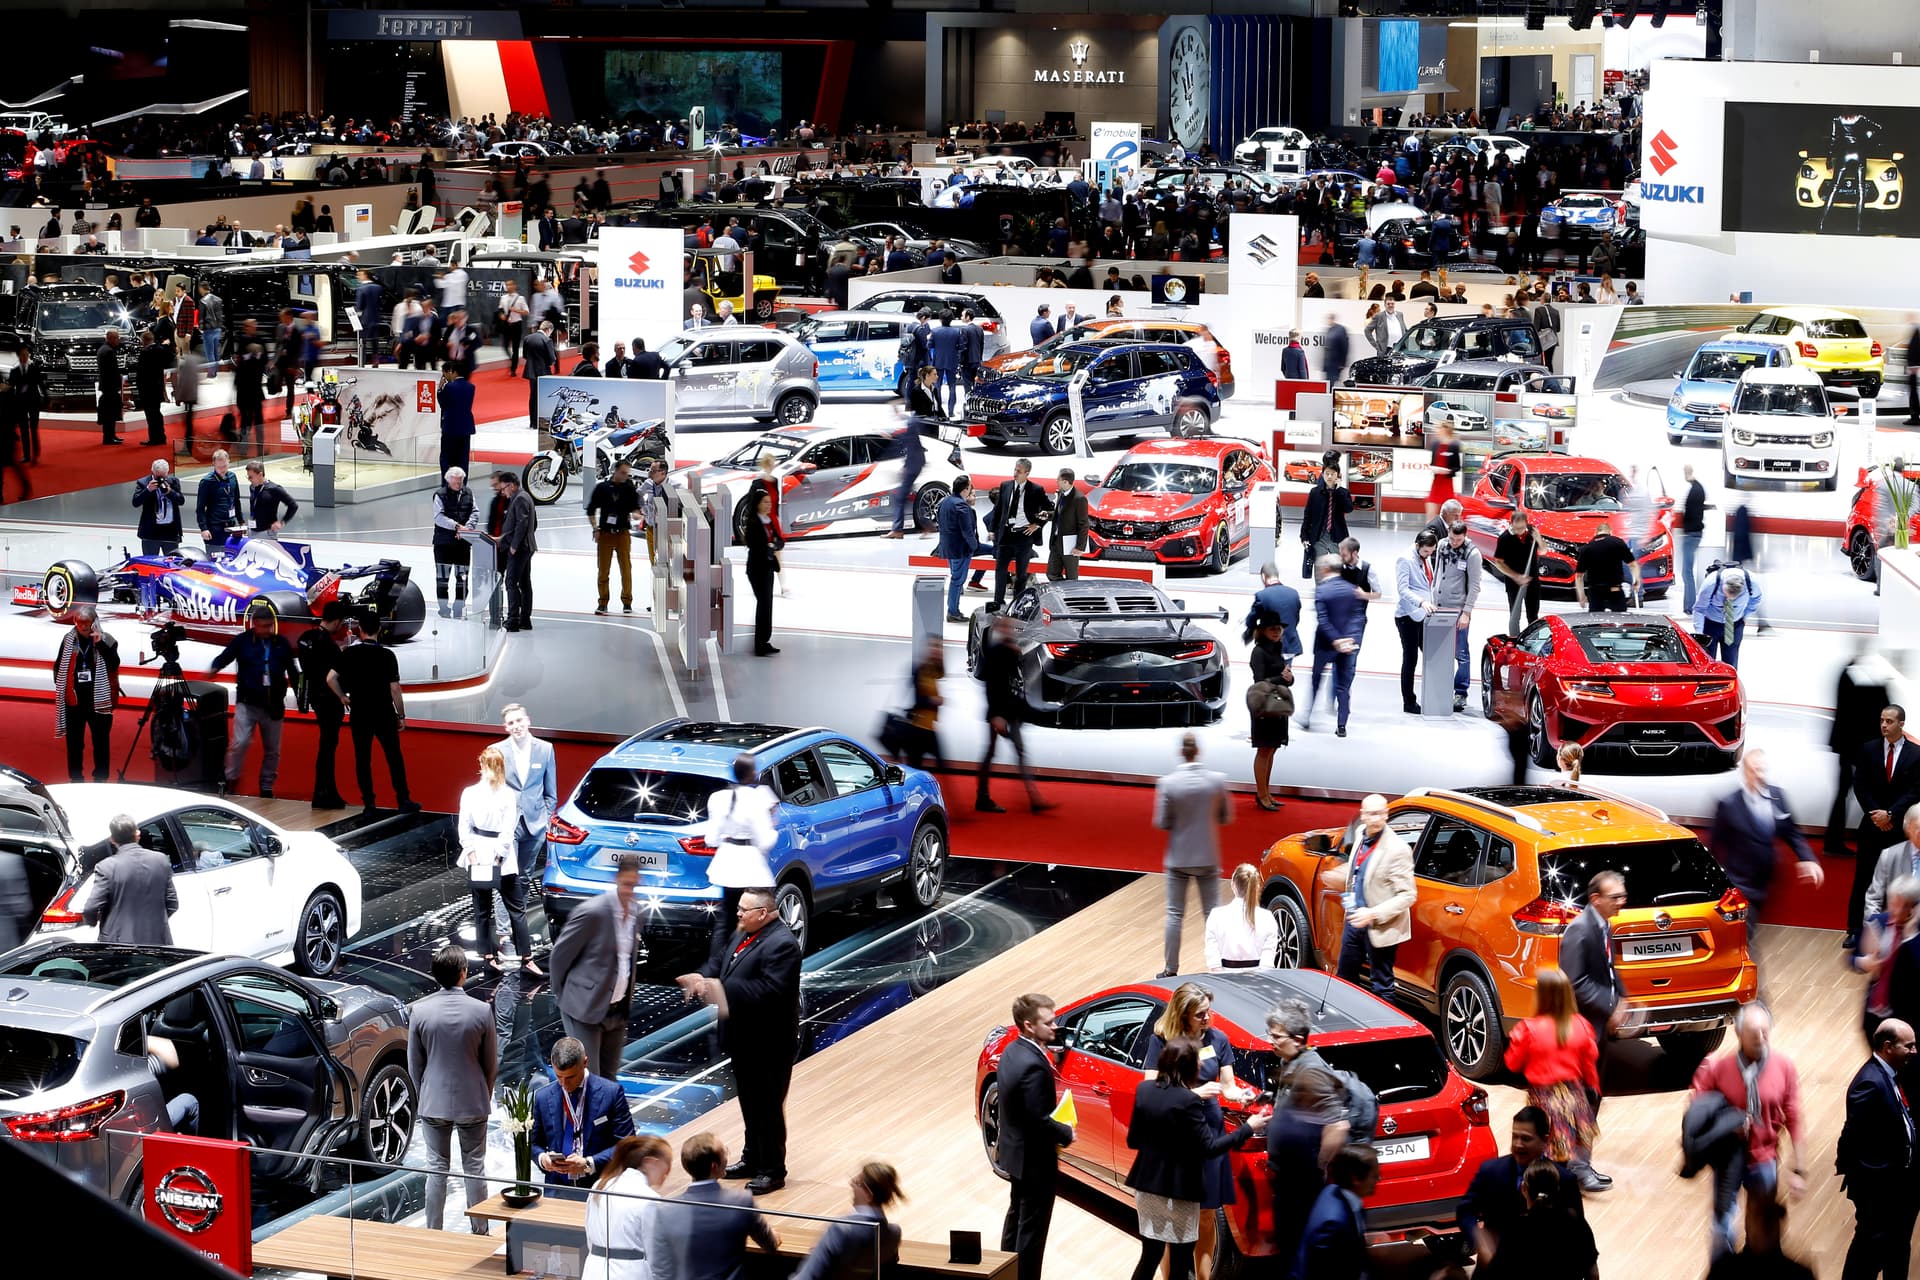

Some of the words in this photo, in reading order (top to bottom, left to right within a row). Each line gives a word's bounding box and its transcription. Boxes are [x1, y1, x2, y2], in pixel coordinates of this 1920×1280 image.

[377, 14, 472, 36] Ferrari
[1034, 70, 1124, 83] MASERATI
[1640, 182, 1704, 204] SUZUKI
[467, 280, 508, 291] ASSEN
[614, 277, 665, 289] SUZUKI
[1254, 332, 1290, 345] Welcom
[1301, 336, 1310, 346] to
[1401, 462, 1430, 471] HON
[796, 505, 851, 522] CIVIC
[852, 497, 881, 512] TCR
[198, 589, 237, 623] Bull
[611, 853, 657, 865] QAQAI
[1633, 942, 1682, 955] NISSAN
[1376, 1143, 1416, 1157] SSAN
[160, 1191, 217, 1209] NISSAN
